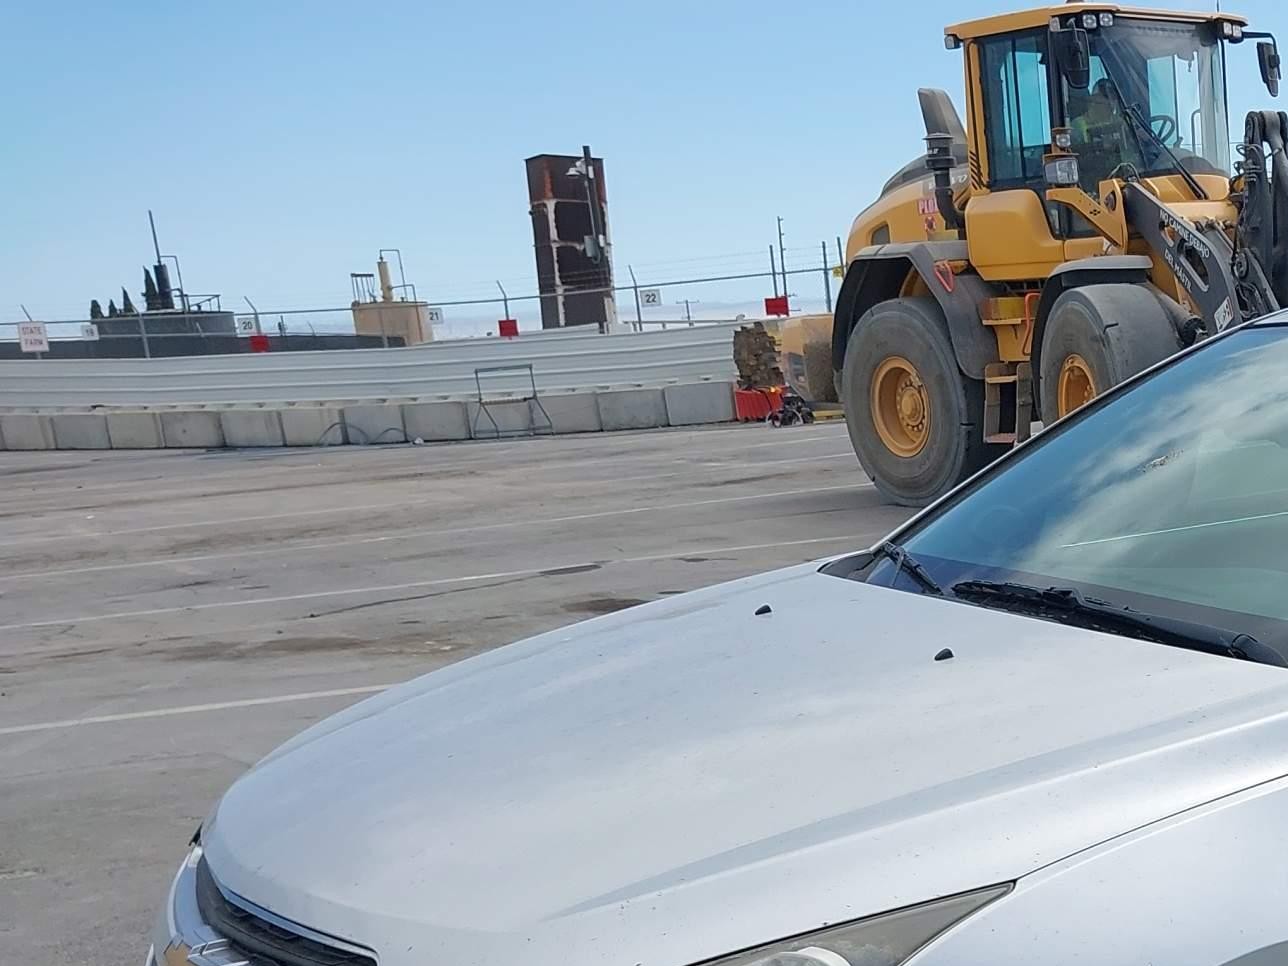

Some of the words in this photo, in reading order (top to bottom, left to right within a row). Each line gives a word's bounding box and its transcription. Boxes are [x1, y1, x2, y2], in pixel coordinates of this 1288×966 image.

[1159, 208, 1169, 223] NO
[645, 292, 657, 304] 22
[428, 311, 440, 321] 21
[242, 320, 253, 330] 20
[21, 326, 42, 336] STATE
